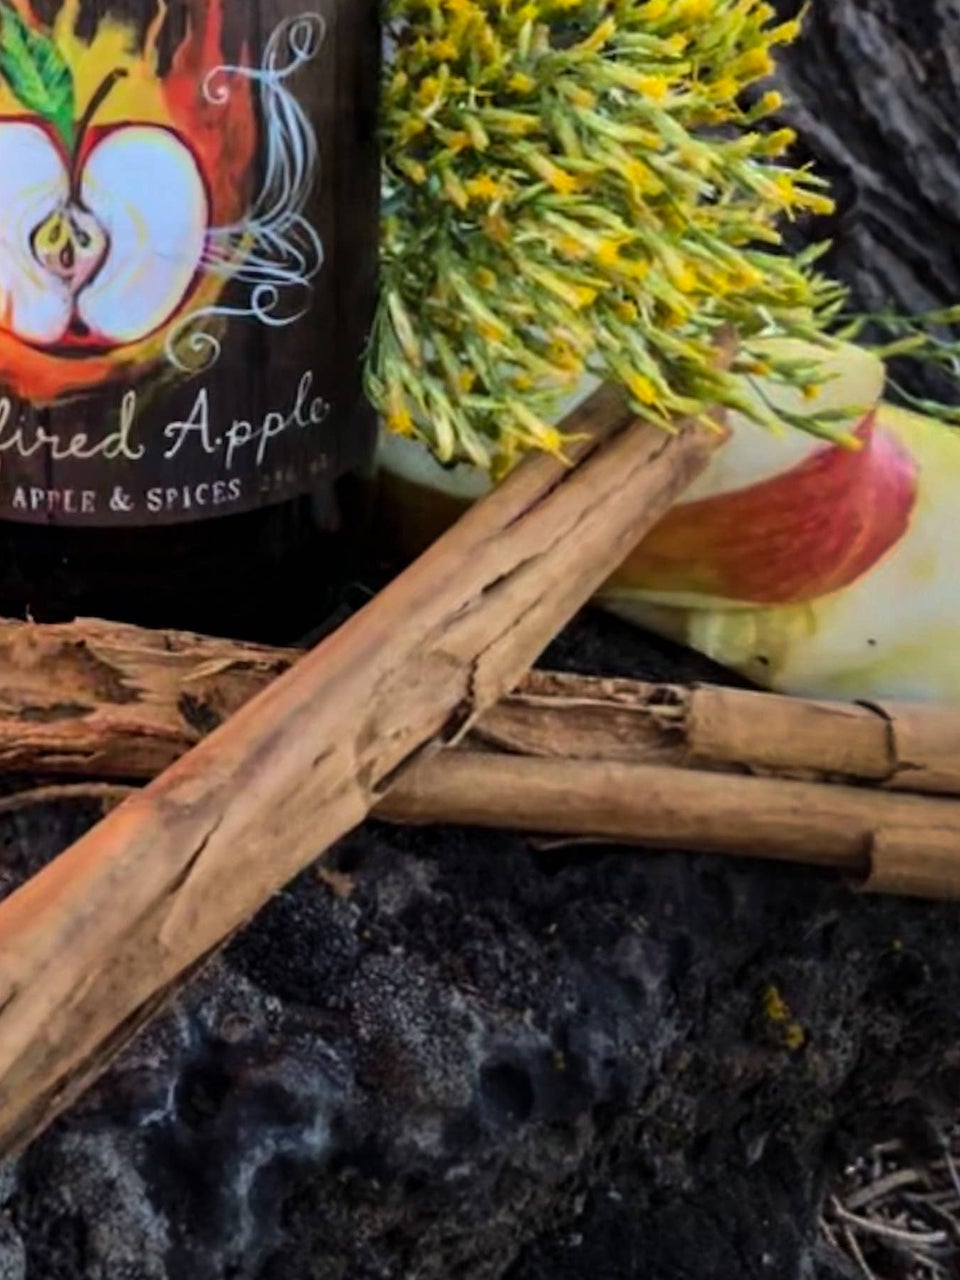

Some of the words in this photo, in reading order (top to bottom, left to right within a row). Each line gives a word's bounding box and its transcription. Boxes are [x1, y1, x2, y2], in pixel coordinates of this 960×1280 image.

[164, 370, 331, 470] Apple
[12, 485, 96, 513] APPLE
[109, 485, 135, 512] &
[146, 478, 242, 512] SPICES
